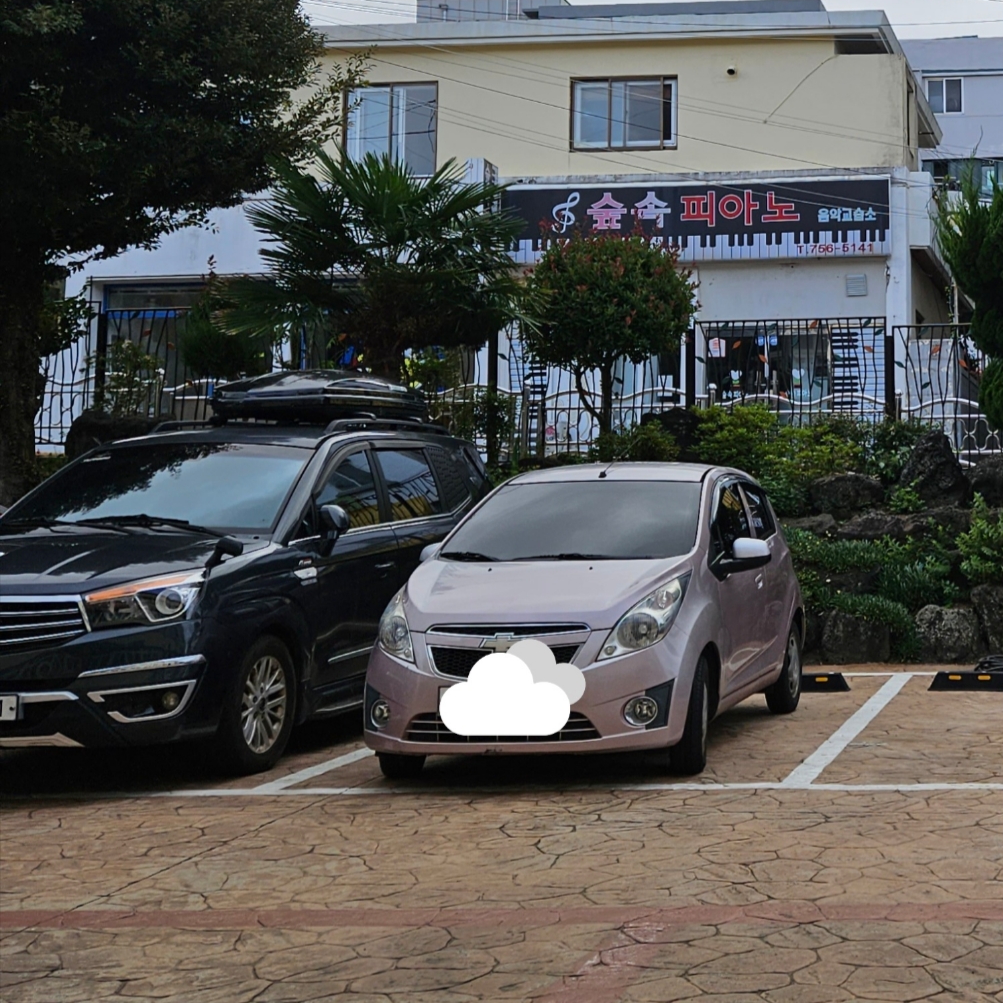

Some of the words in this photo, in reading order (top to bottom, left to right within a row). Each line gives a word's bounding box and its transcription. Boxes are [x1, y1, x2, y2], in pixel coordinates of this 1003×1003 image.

[587, 191, 671, 229] 숲속
[680, 189, 800, 228] 피아노
[817, 207, 876, 223] 음악교습소
[797, 243, 874, 255] T.756-5141
